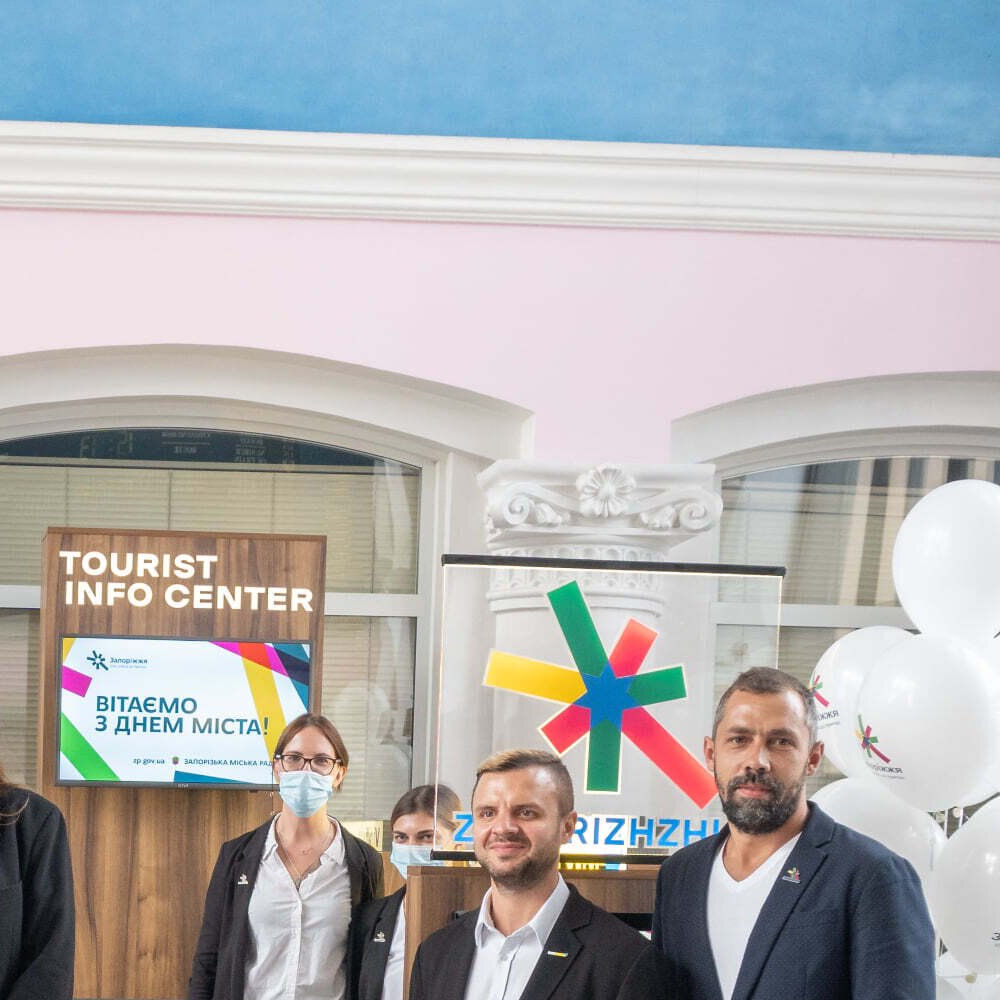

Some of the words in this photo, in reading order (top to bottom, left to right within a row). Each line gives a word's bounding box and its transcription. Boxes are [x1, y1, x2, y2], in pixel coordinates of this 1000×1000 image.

[59, 551, 218, 579] TOURIST
[65, 581, 153, 607] INFO
[164, 584, 314, 612] CENTER
[96, 695, 198, 714] ВІТАЄМО
[95, 715, 107, 732] З
[114, 716, 183, 735] ДНЕМ
[192, 717, 268, 735] МІСТА!
[184, 758, 228, 766] ЗАПОРІЗЬКА
